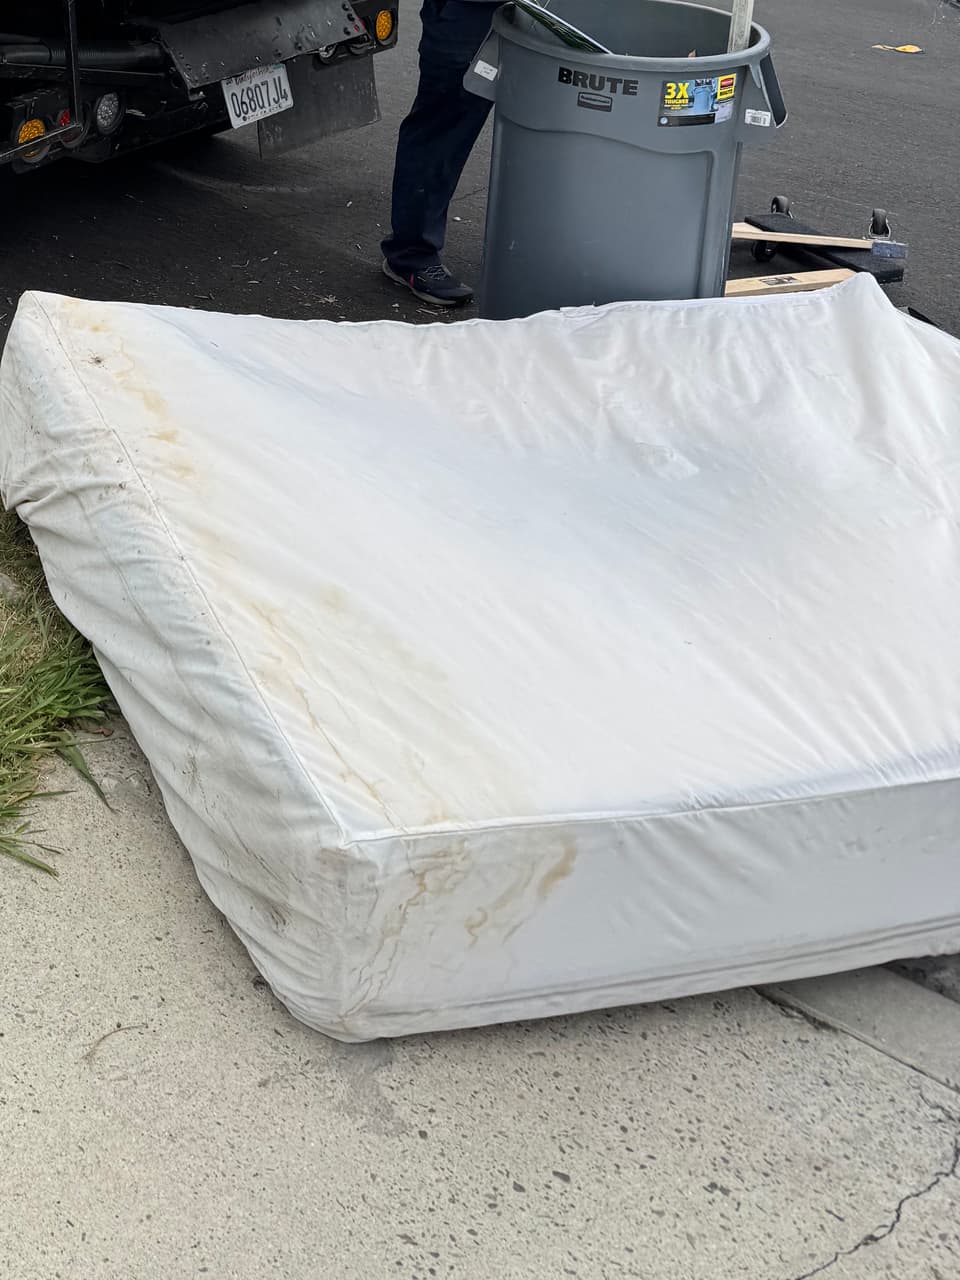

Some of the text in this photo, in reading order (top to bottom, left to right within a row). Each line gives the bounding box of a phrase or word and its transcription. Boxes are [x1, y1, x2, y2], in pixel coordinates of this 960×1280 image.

[557, 66, 639, 96] BRUTE
[665, 82, 690, 99] 3X
[230, 76, 289, 118] 06807J4
